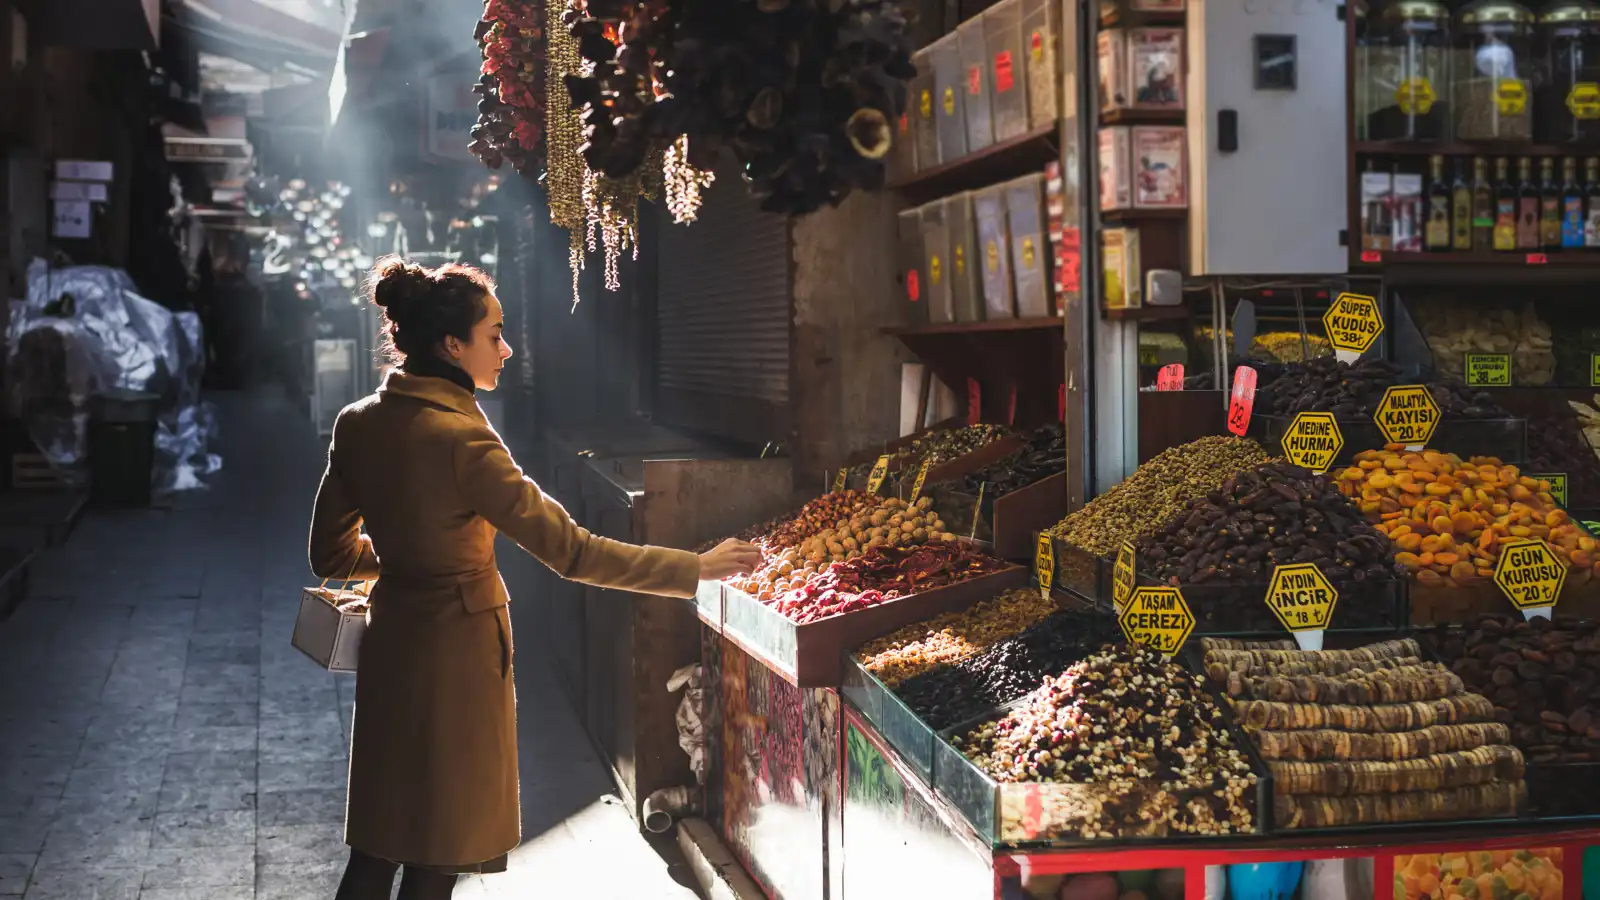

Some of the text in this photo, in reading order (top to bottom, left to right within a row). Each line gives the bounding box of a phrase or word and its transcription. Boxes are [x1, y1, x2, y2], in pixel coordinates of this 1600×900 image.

[1340, 299, 1371, 317] SÜPER
[1332, 316, 1376, 334] KUDÜS
[1390, 394, 1427, 409] MALATYA
[1385, 409, 1433, 425] KAYISI
[1398, 425, 1414, 439] 20
[1290, 436, 1335, 452] HURMA
[1510, 548, 1544, 567] GÜN
[1282, 573, 1316, 590] AYDIN
[1503, 564, 1558, 586] KURUSU
[1522, 585, 1540, 601] 20
[1140, 594, 1175, 612] YAŞAM
[1296, 612, 1308, 624] 18
